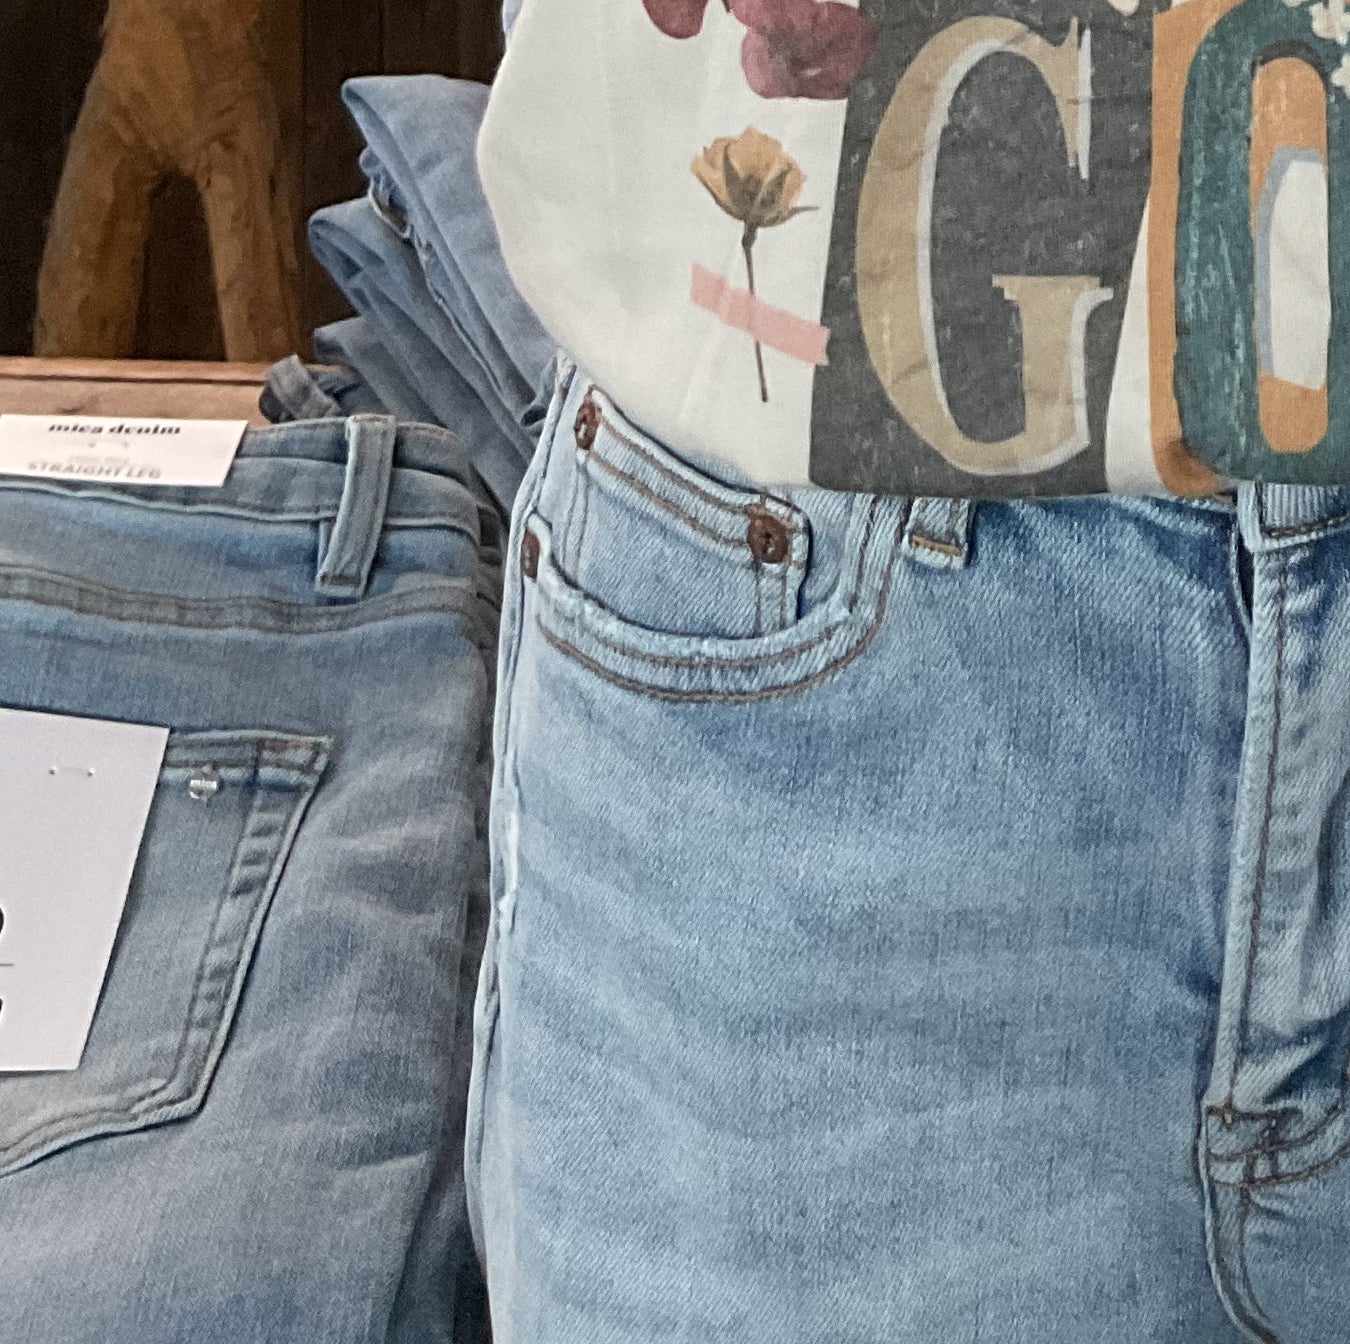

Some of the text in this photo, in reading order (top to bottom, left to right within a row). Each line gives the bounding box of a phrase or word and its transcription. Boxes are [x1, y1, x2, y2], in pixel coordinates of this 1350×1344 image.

[108, 422, 182, 435] denim
[27, 461, 163, 480] STRAIGHT LEG
